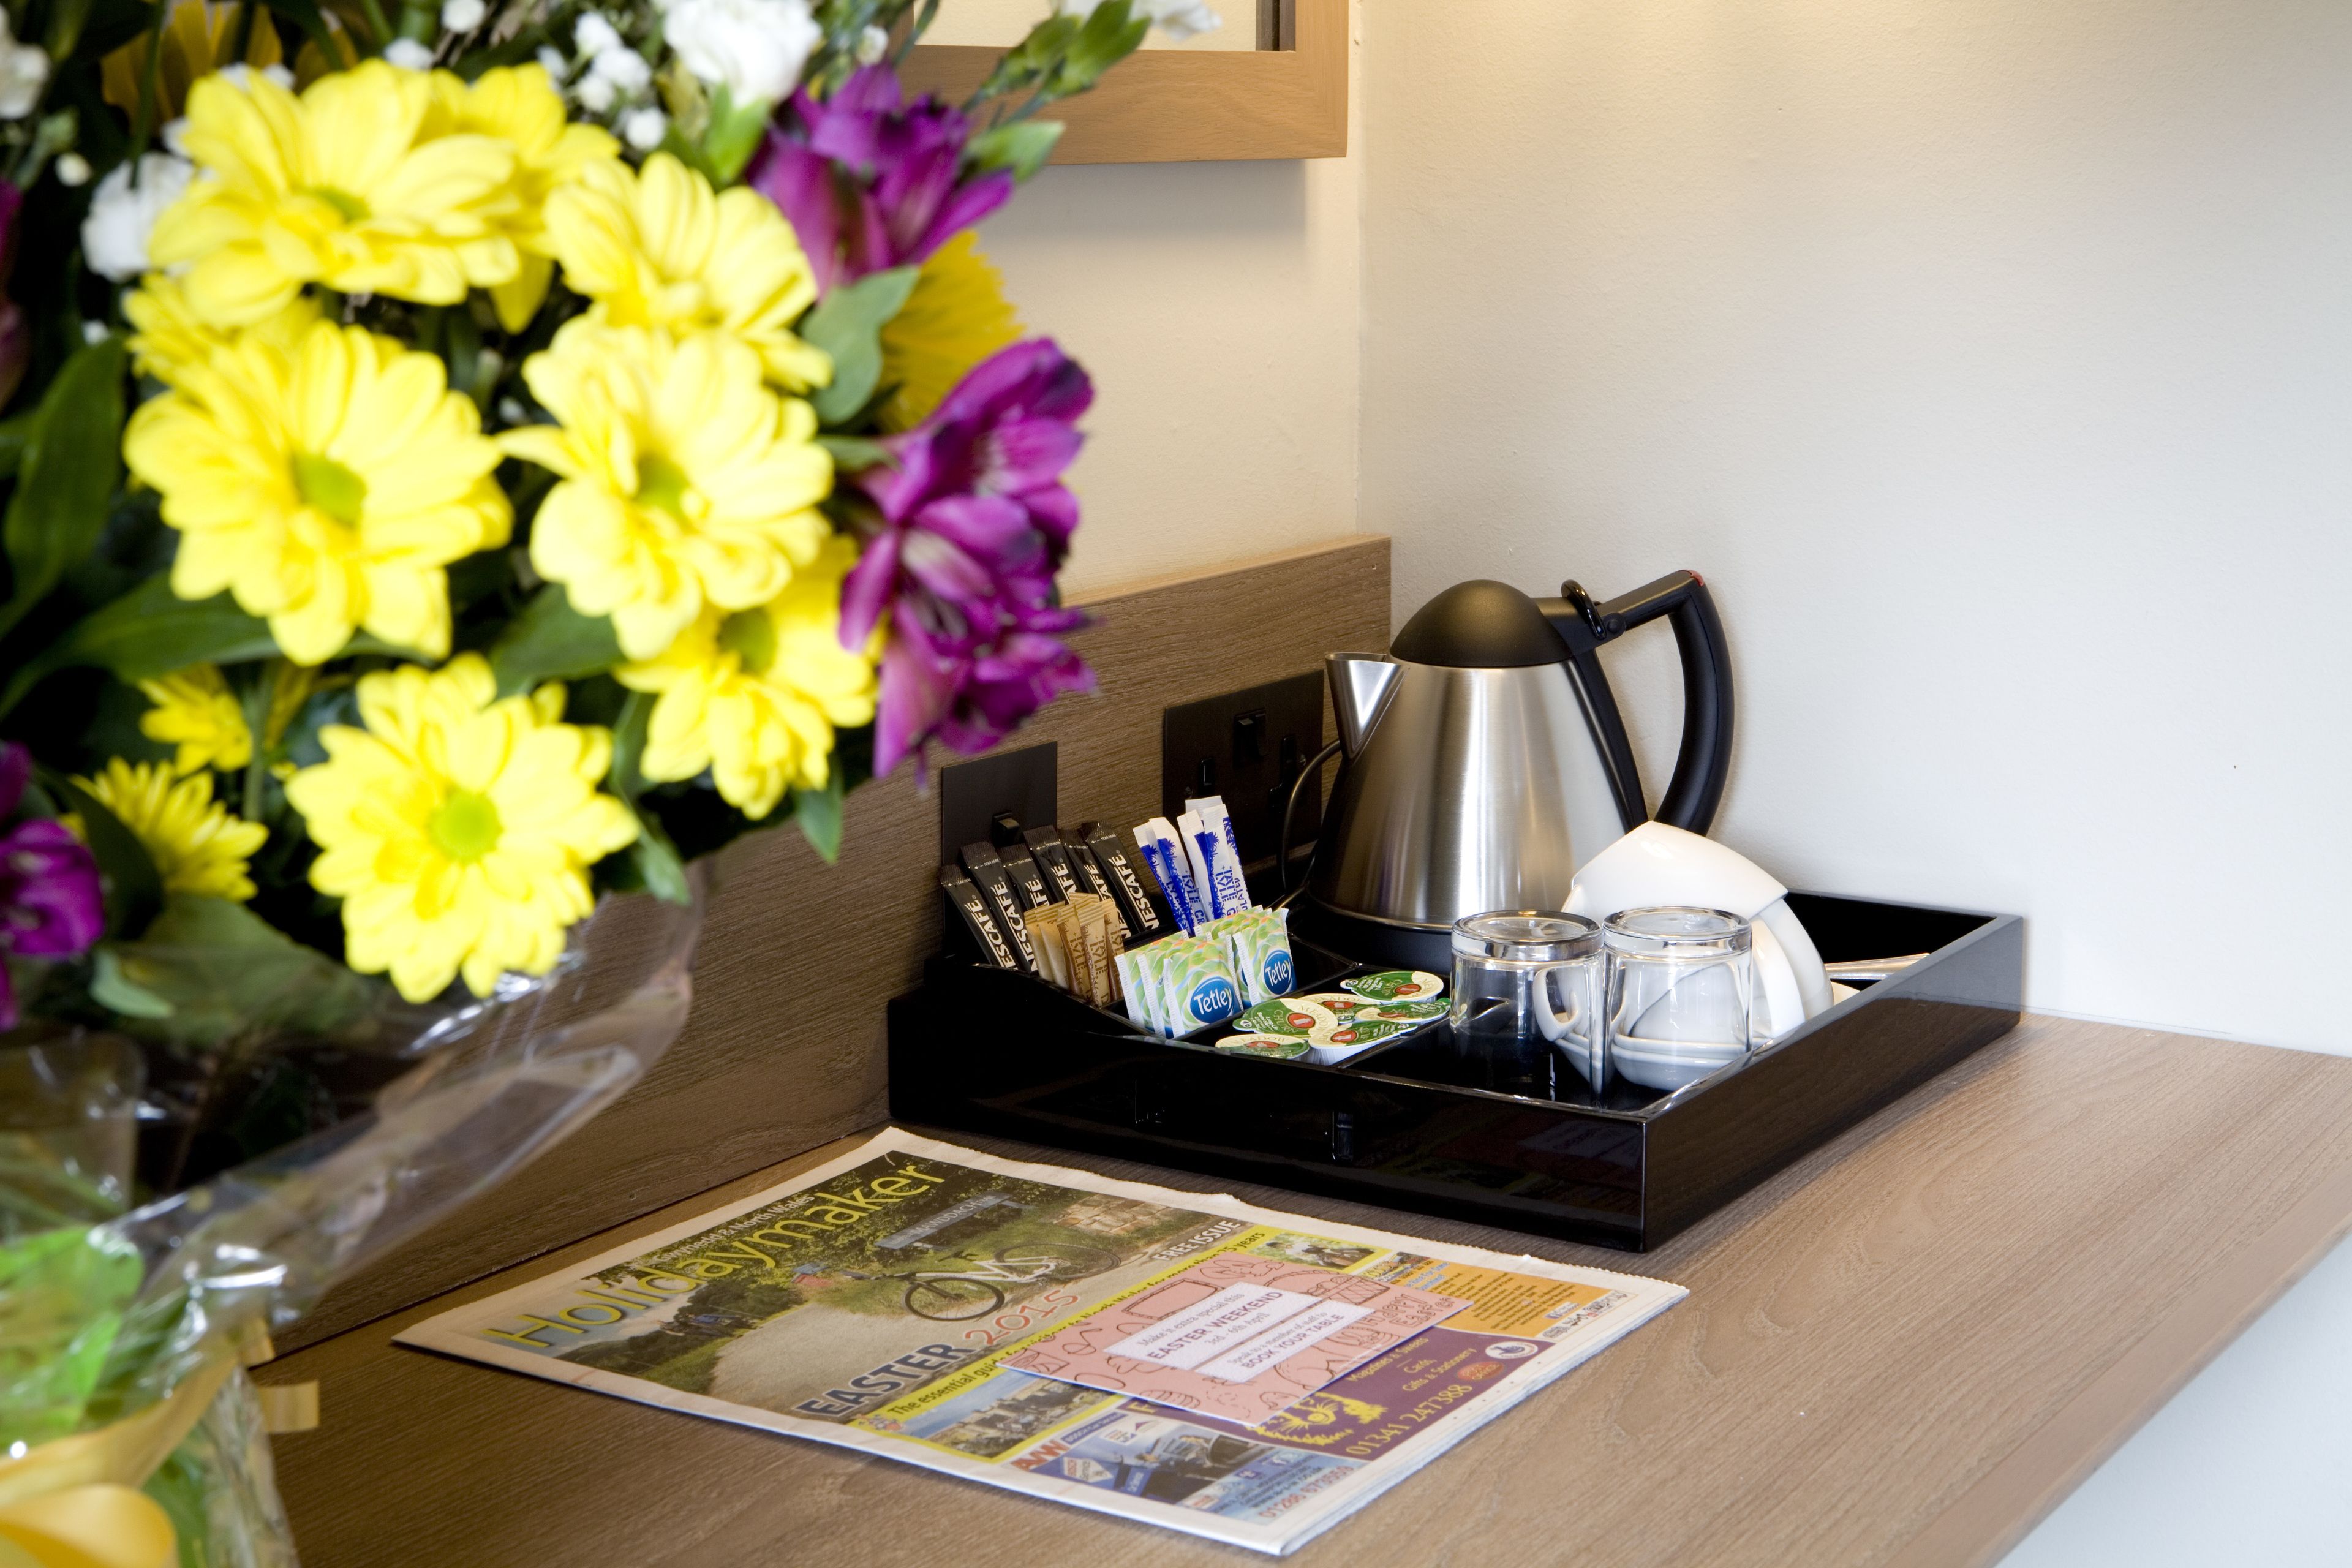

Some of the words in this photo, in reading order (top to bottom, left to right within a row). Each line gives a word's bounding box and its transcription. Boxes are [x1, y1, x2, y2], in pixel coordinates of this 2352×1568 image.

[964, 899, 1017, 970] ESCAFÉ
[1194, 984, 1234, 1014] Tetley
[1265, 959, 1292, 986] Tetley
[654, 1233, 722, 1262] Gwynedd
[731, 1212, 774, 1234] North
[767, 1195, 815, 1215] Wales
[1152, 1240, 1197, 1261] FREE
[1193, 1220, 1242, 1246] ISSUE
[482, 1165, 945, 1348] Holidaymaker
[888, 1398, 921, 1416] The
[918, 1373, 977, 1406] essential
[1234, 1232, 1266, 1253] years
[1137, 1332, 1162, 1346] Make
[1174, 1315, 1198, 1329] extra
[1196, 1301, 1225, 1320] special
[1224, 1292, 1245, 1303] this
[1147, 1328, 1212, 1359] EASTER
[1205, 1291, 1283, 1328] WEEKEND
[1204, 1335, 1226, 1346] 3rd
[1228, 1324, 1248, 1334] 6th
[1245, 1312, 1270, 1326] April
[1242, 1349, 1280, 1368] BOOK
[1275, 1332, 1311, 1349] YOUR
[1305, 1314, 1345, 1332] TABLE
[796, 1342, 978, 1417] EASTER
[964, 1289, 1079, 1346] 2015
[1345, 1356, 1393, 1382] Magazines
[1396, 1337, 1429, 1354] Sweets
[1402, 1377, 1429, 1392] Gifts
[1430, 1348, 1477, 1374] Stationery
[1346, 1423, 1411, 1455] 01341
[1400, 1384, 1472, 1422] 247388
[1011, 1440, 1071, 1472] AVW
